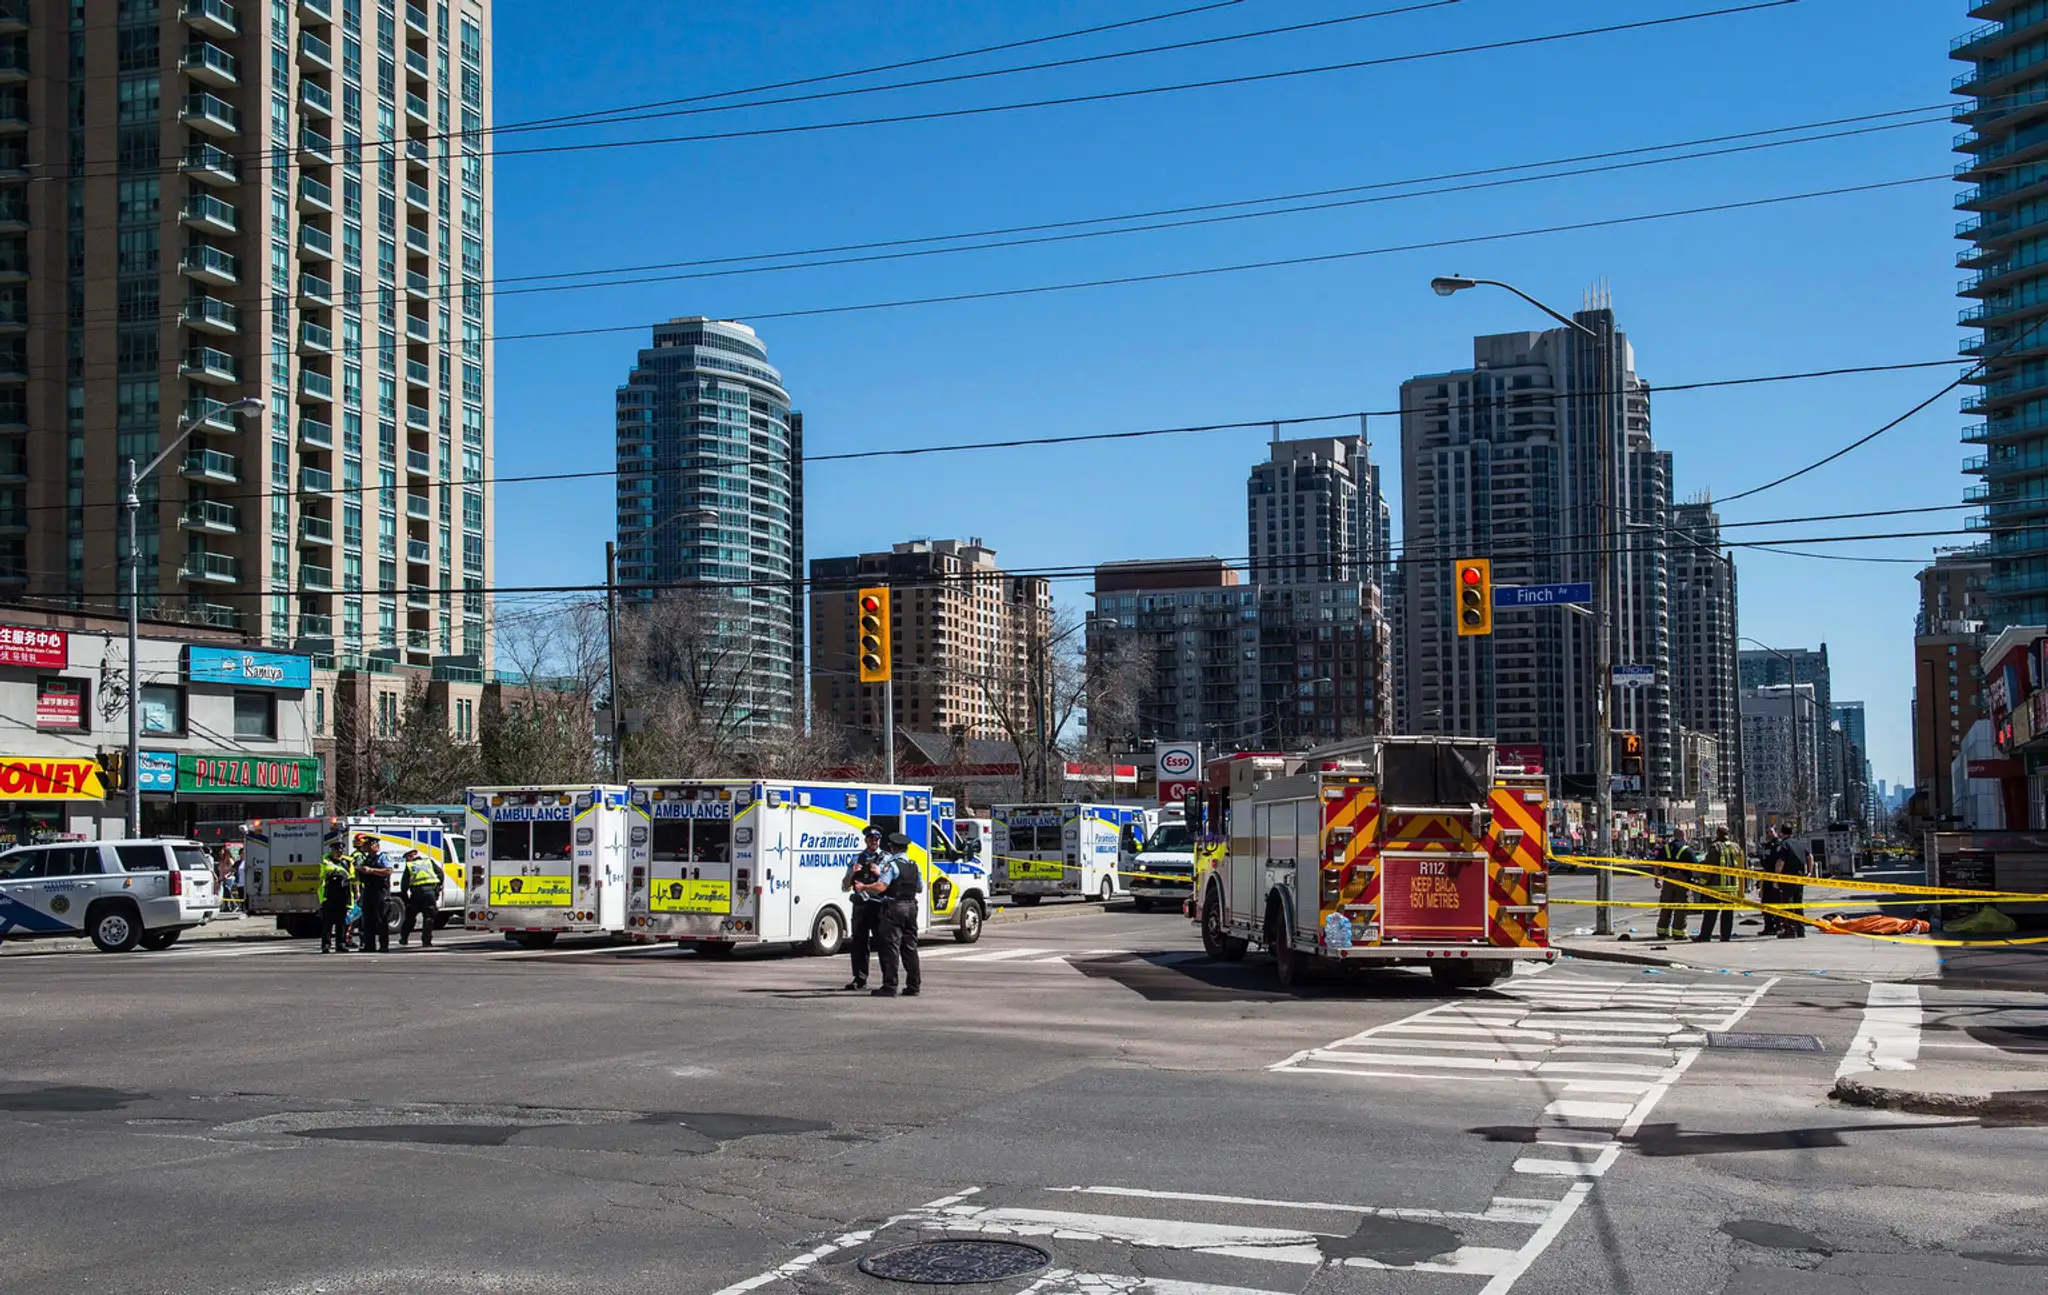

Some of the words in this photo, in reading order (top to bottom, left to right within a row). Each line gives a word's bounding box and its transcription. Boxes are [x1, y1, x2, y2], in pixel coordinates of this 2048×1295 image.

[1517, 588, 1553, 602] Finch
[1558, 587, 1568, 595] Av
[242, 655, 284, 683] Kamiya
[1166, 756, 1190, 767] Esso
[0, 762, 94, 794] ONEY
[196, 759, 250, 788] PIZZA
[257, 761, 301, 789] NOVA
[495, 808, 570, 820] AMBULANCE
[655, 803, 729, 818] AMBULANCE
[1010, 817, 1061, 826] AMBULANCE
[799, 833, 860, 848] Paramedic
[799, 854, 851, 867] AMBULANC
[1420, 861, 1445, 875] R112
[775, 879, 790, 889] 9-1-1
[1411, 876, 1432, 892] KEEP
[1434, 876, 1457, 892] BACK
[1410, 893, 1424, 908] 150
[1427, 893, 1460, 909] METRES
